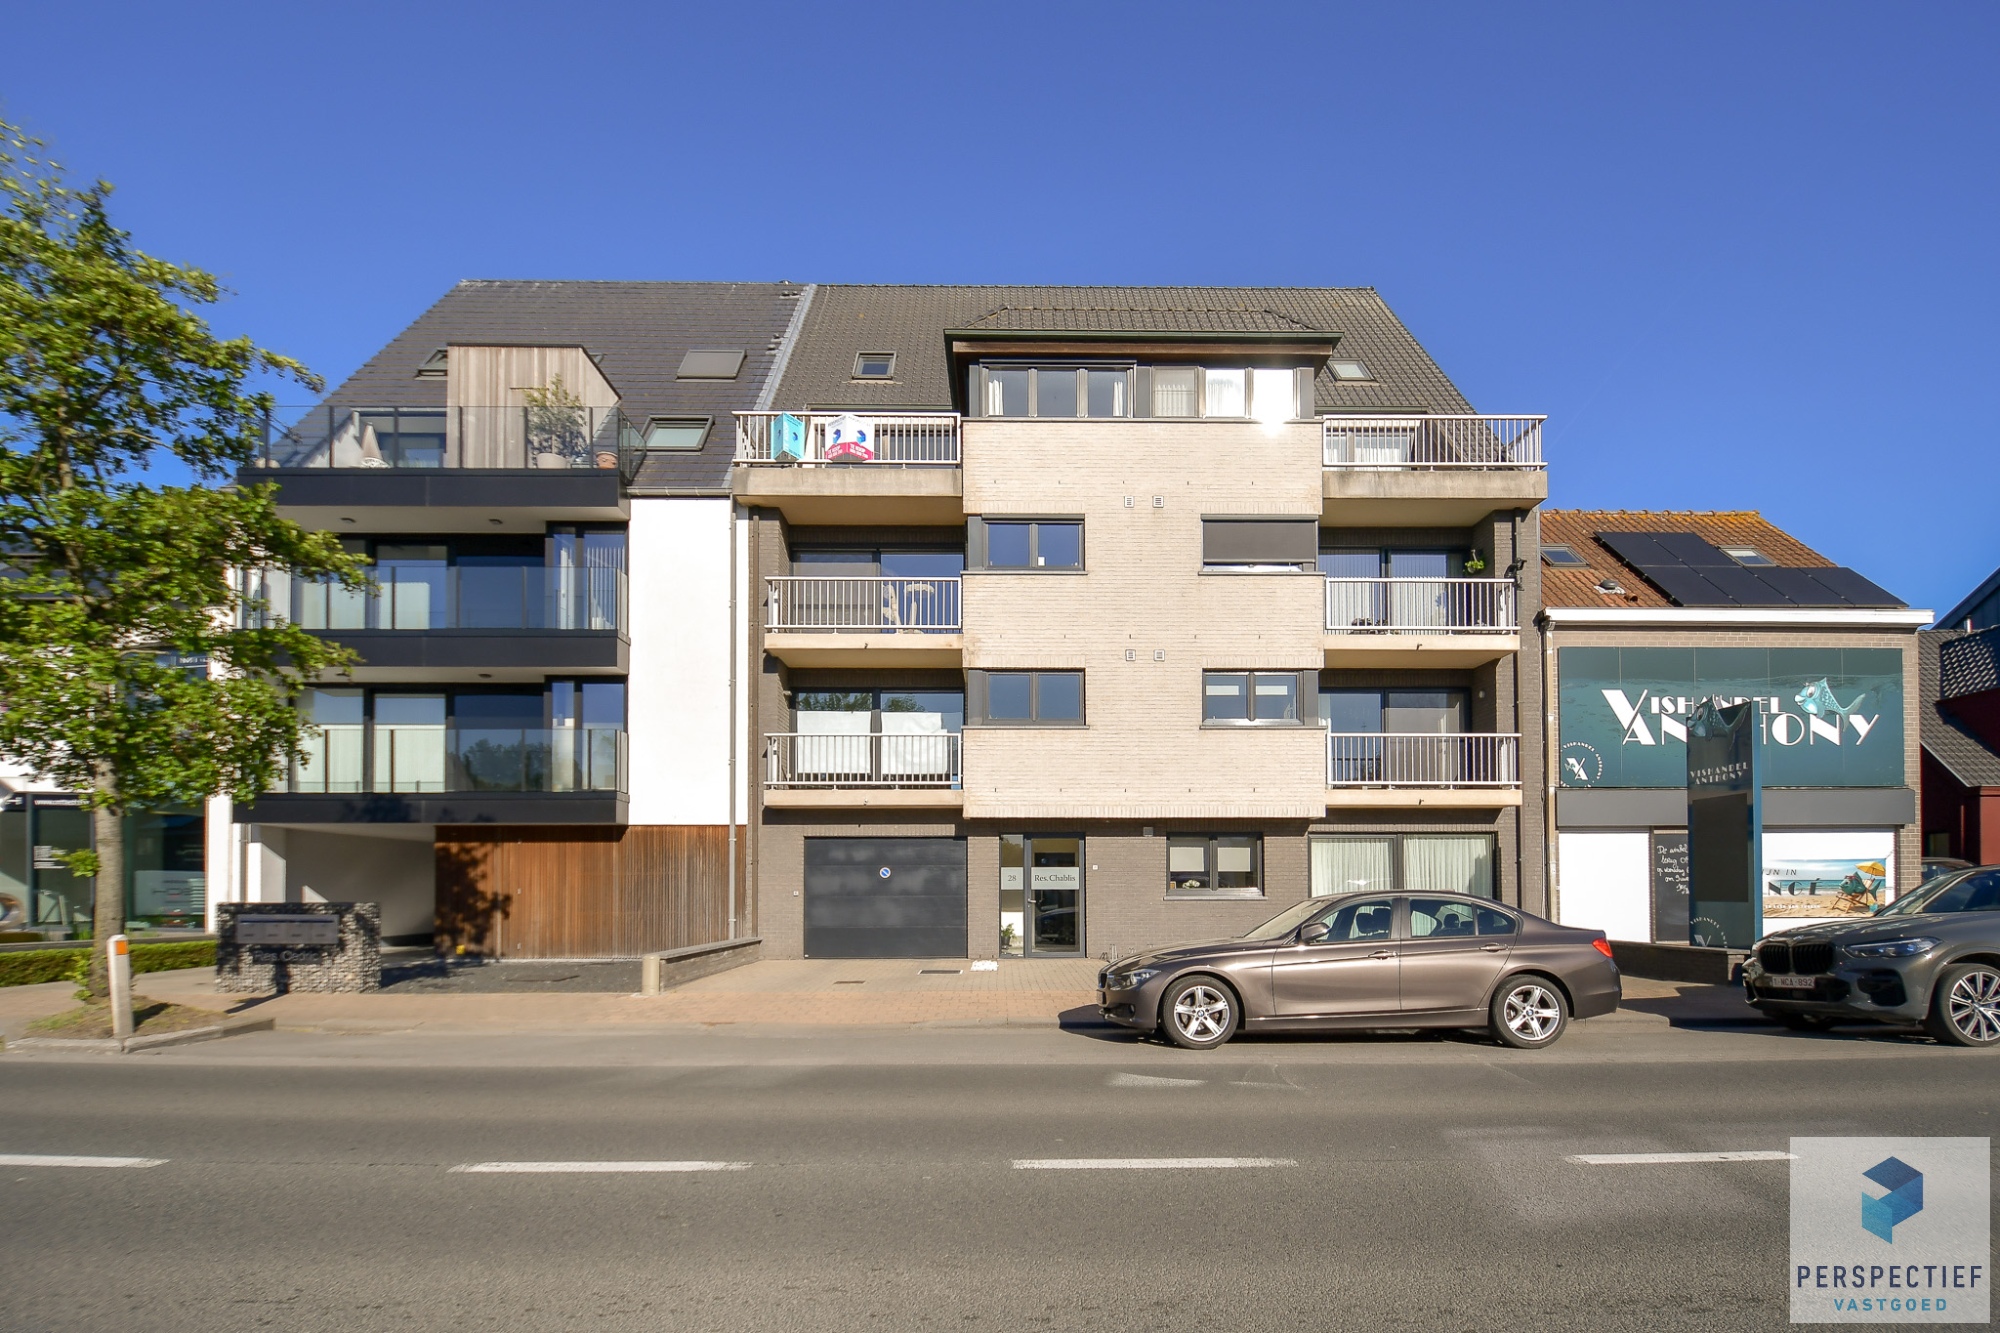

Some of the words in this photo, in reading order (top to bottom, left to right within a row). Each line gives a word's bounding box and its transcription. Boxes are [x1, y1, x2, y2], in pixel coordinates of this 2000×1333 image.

[1690, 762, 1749, 778] VISHANDEL
[1695, 771, 1743, 785] ANTHONY
[1007, 874, 1017, 882] 28
[1034, 874, 1049, 882] Res.
[1049, 874, 1076, 882] Chablis
